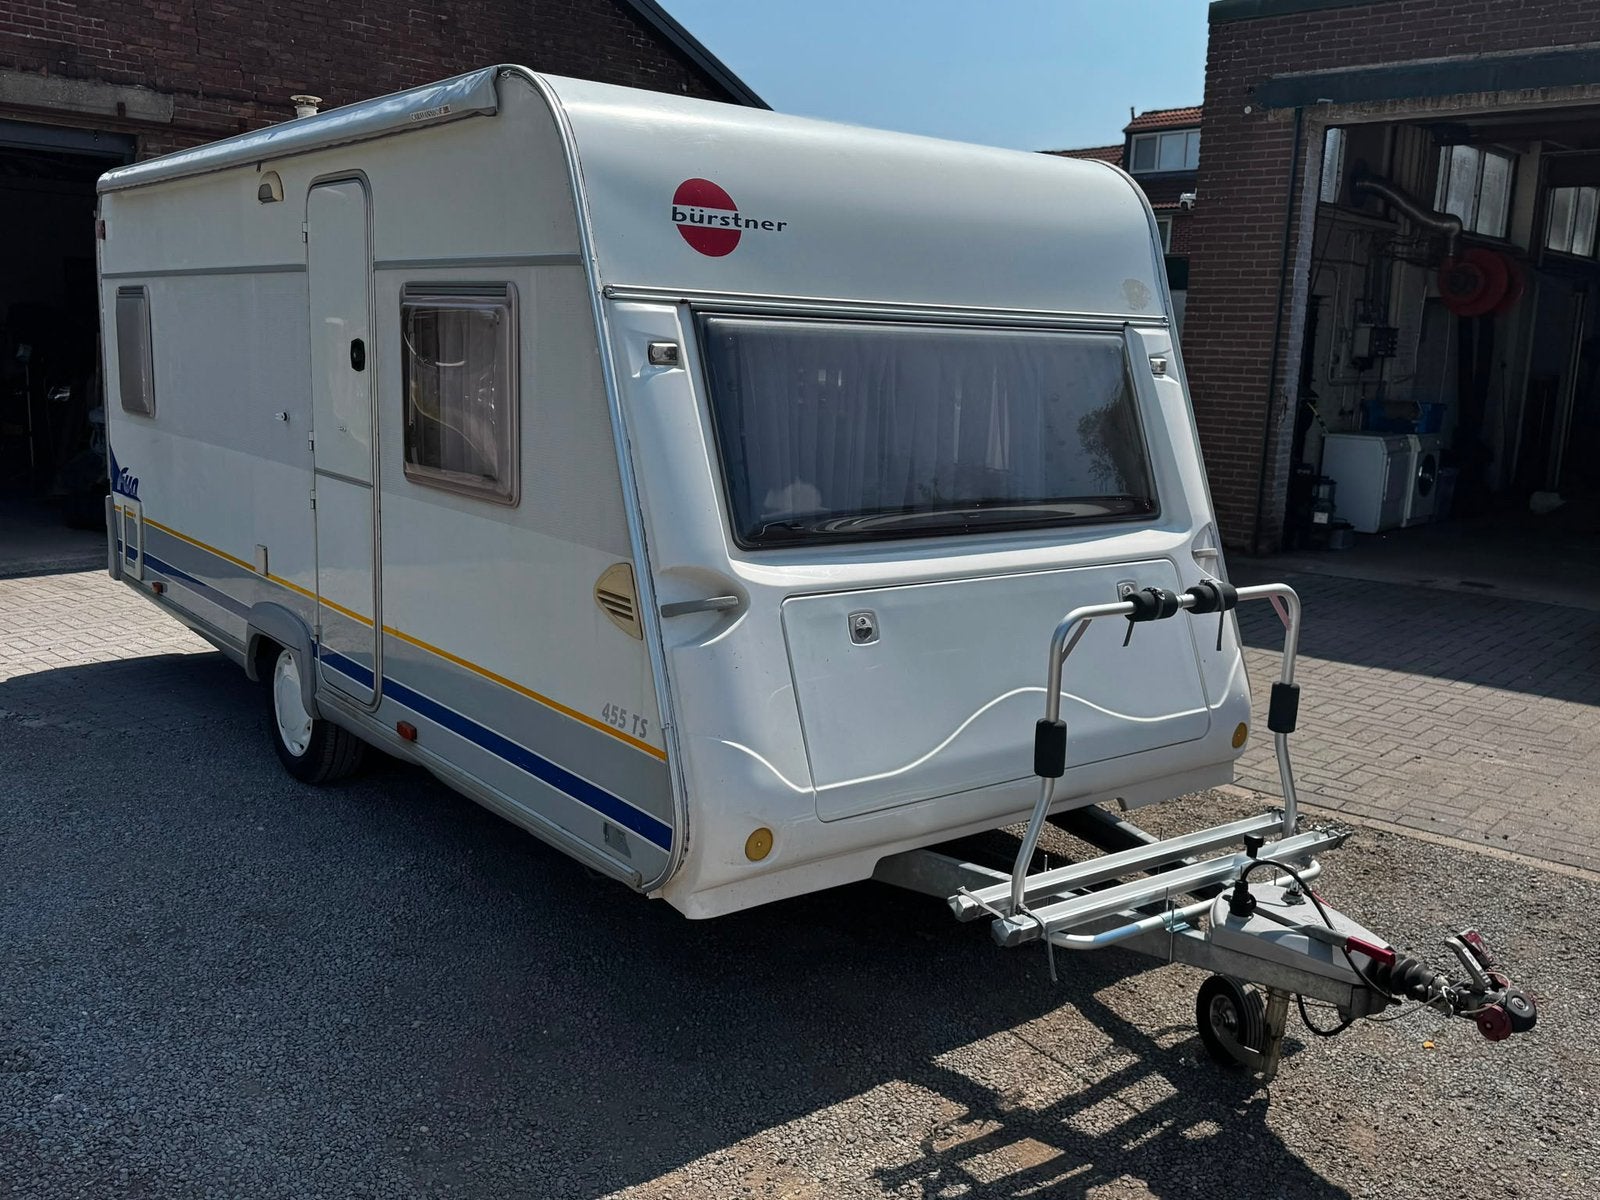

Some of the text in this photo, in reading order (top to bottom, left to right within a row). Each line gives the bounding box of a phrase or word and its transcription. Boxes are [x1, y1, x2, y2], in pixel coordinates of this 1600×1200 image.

[672, 206, 787, 232] bürstner
[602, 703, 648, 739] 455 TS
